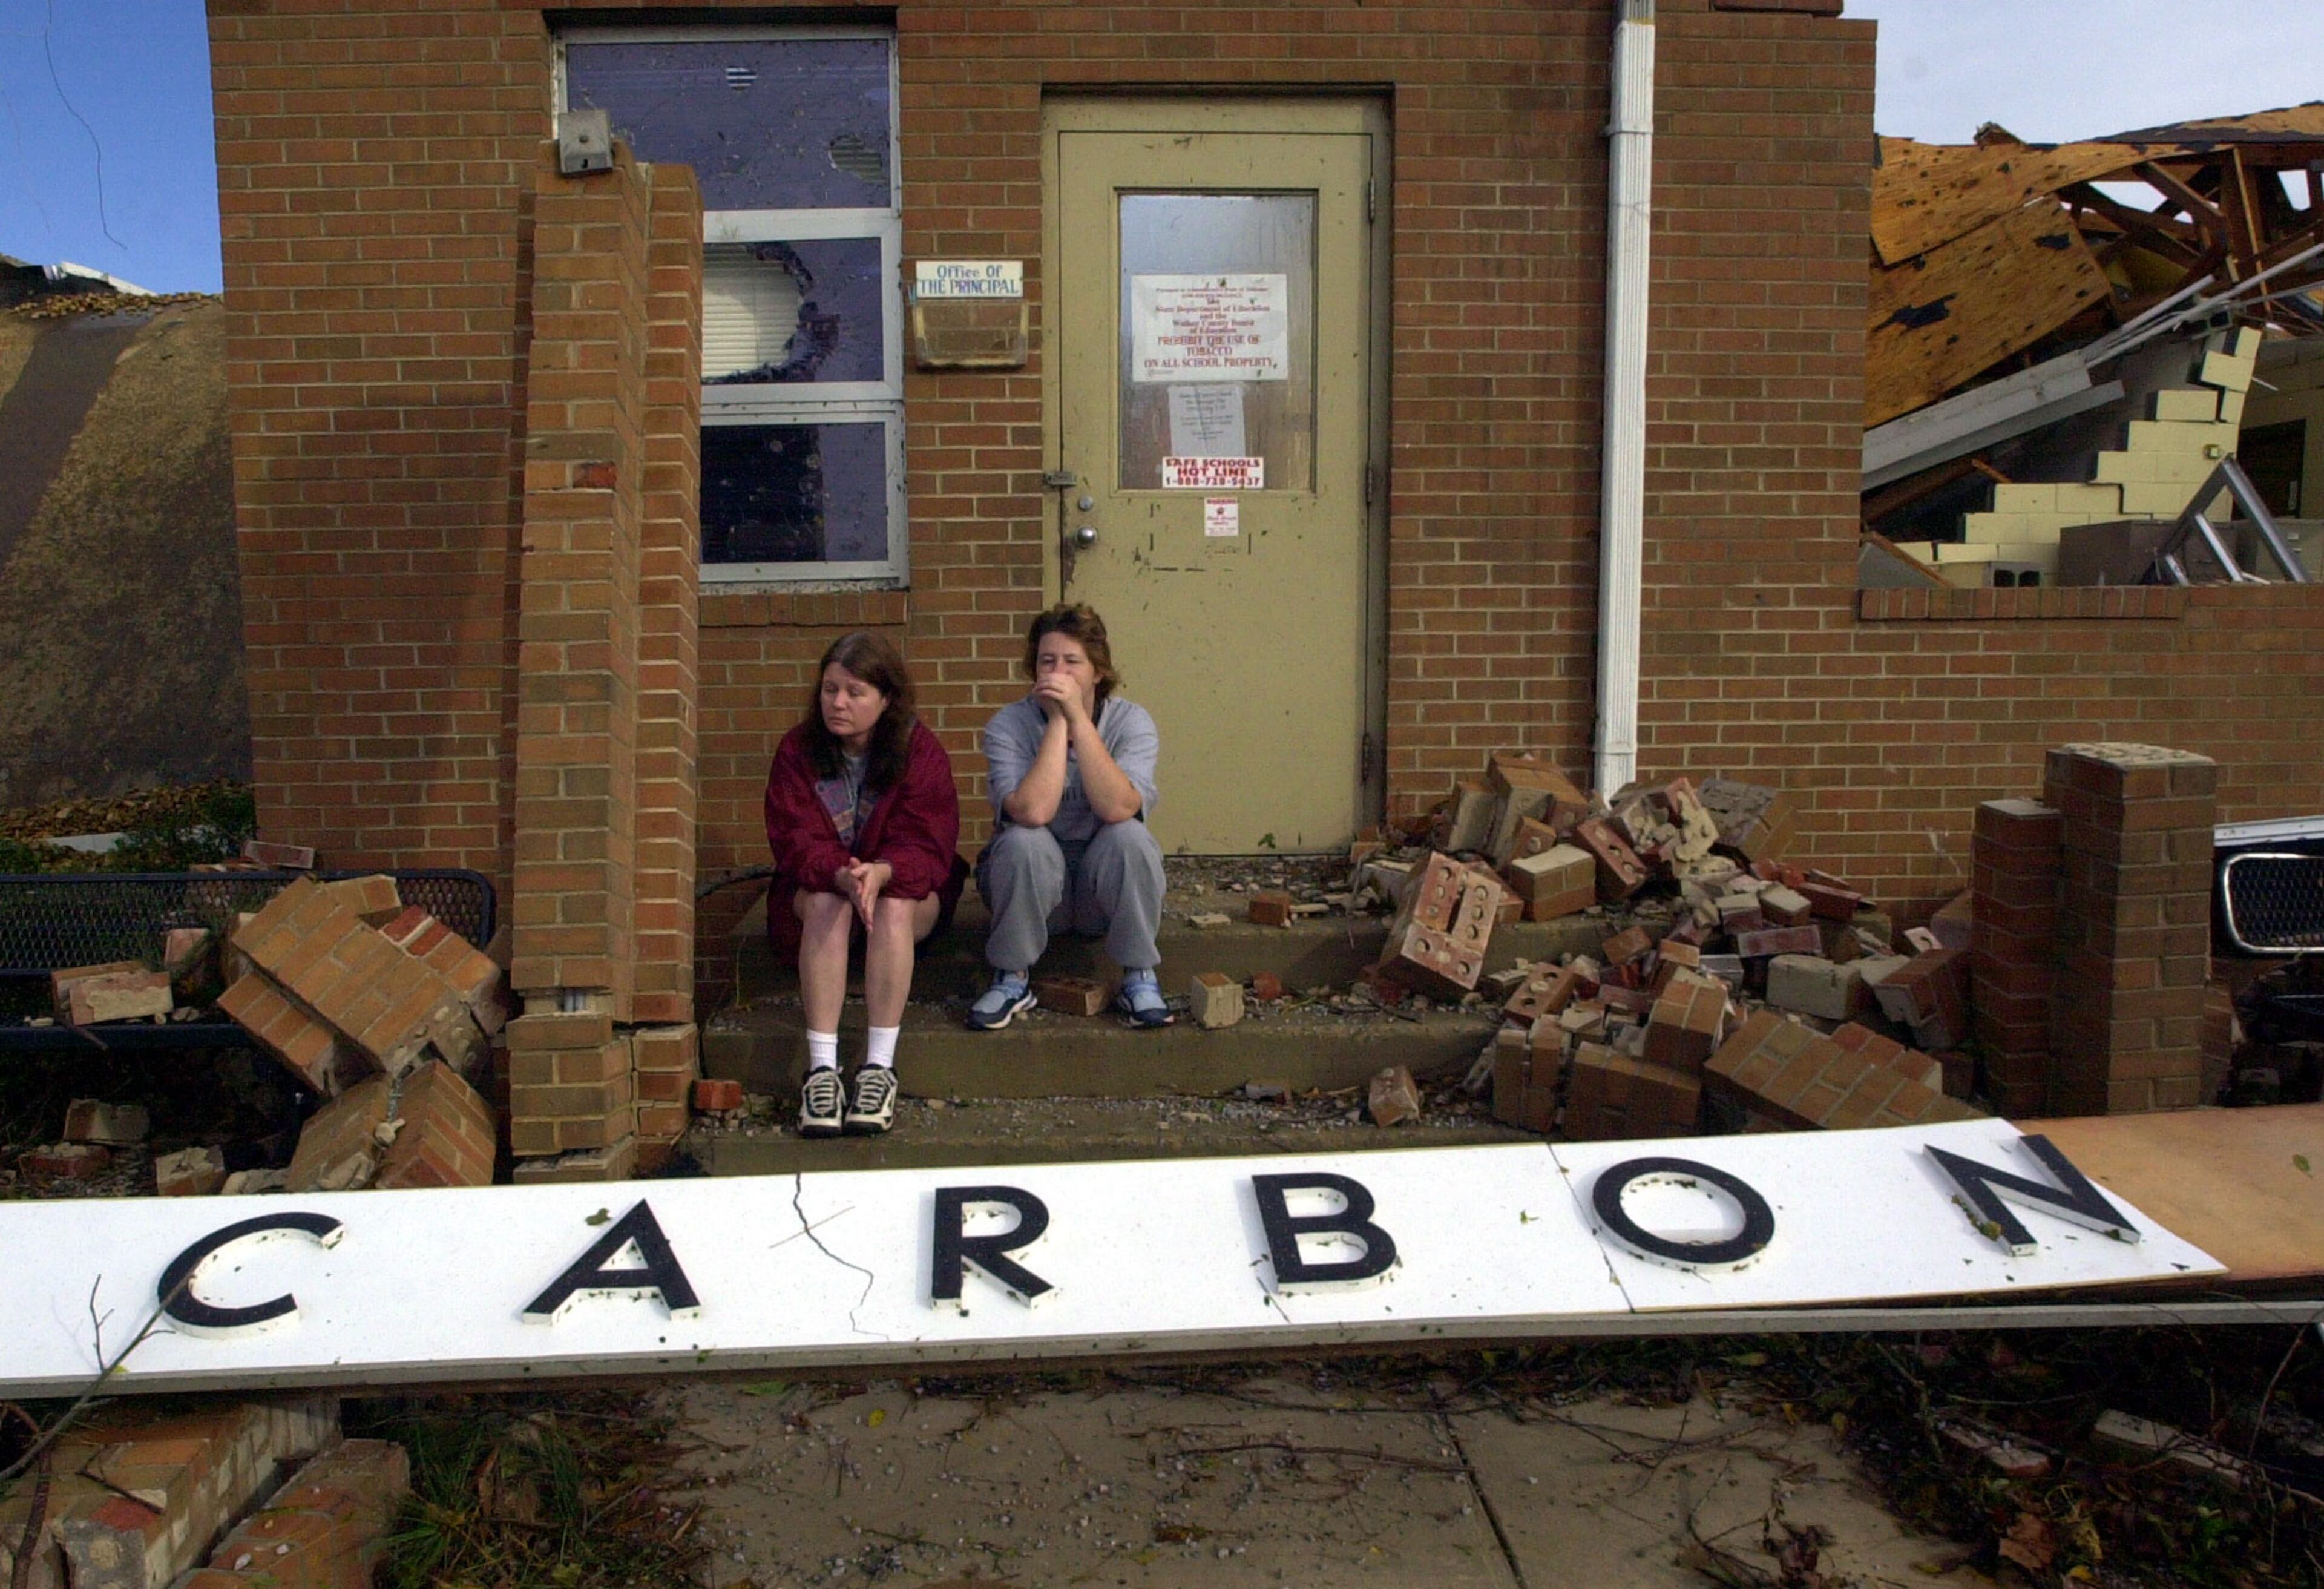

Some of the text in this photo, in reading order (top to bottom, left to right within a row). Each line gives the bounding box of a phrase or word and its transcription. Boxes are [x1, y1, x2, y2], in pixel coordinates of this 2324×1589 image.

[919, 279, 1019, 294] THE PRINCIPAL
[1157, 335, 1261, 346] PROHIBIT THE USE OF
[1187, 347, 1233, 357] TOBACCO
[1144, 357, 1272, 368] ON ALL SCHOOL PROPERTY
[1203, 459, 1260, 467] SCHOOLS
[1177, 468, 1248, 476] HOT LINE
[156, 1134, 2141, 1335] CARBON
